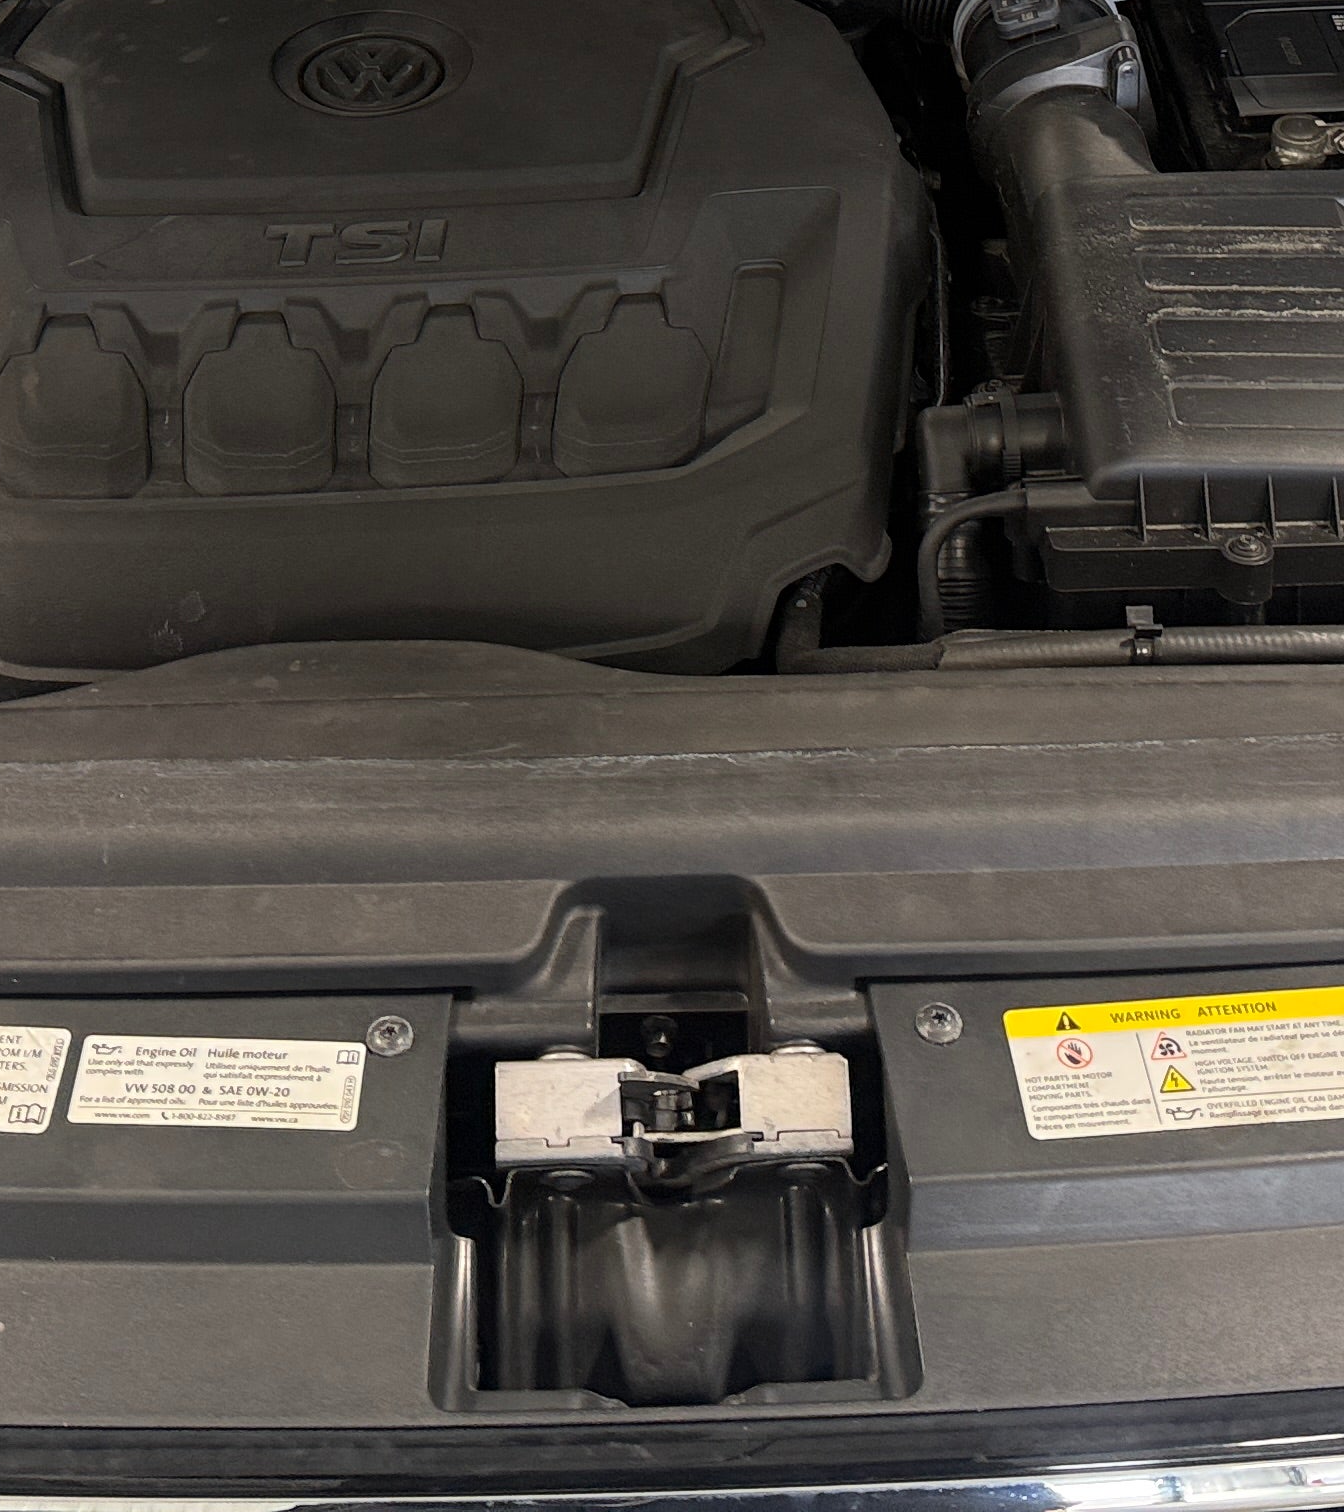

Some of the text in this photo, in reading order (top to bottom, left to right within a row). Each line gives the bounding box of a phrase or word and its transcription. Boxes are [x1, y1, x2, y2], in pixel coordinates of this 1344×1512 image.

[264, 218, 448, 268] TSI
[1110, 1001, 1277, 1024] WARNING ATTENTION
[1186, 1028, 1227, 1036] RADIATOR
[1292, 1021, 1302, 1029] AT
[1304, 1020, 1320, 1028] ANY
[1300, 1032, 1320, 1040] peut
[136, 1047, 288, 1060] Engine Oil Huile moteur
[1257, 1054, 1288, 1062] SWITCH
[1290, 1052, 1305, 1061] OFF
[1308, 1051, 1338, 1060] ENGINE
[88, 1058, 104, 1066] Use
[156, 1060, 194, 1069] expressly
[238, 1064, 290, 1072] uniquement
[86, 1068, 122, 1076] complies
[1197, 1066, 1234, 1075] IGNITION
[1044, 1074, 1070, 1083] PARTS
[1082, 1072, 1112, 1080] MOTOR
[1200, 1076, 1225, 1085] Haute
[1294, 1070, 1303, 1078] le
[1304, 1069, 1334, 1078] moteur
[125, 1083, 148, 1093] VW
[152, 1084, 175, 1093] 508
[178, 1084, 196, 1094] 00
[219, 1086, 243, 1096] SAE
[247, 1086, 290, 1097] 0W-20
[127, 1097, 168, 1105] approved
[198, 1098, 218, 1106] Pour
[1029, 1092, 1064, 1101] MOVING
[1032, 1102, 1082, 1112] Composants
[1207, 1100, 1257, 1110] OVERFILLED
[1260, 1097, 1290, 1106] ENGINE
[1293, 1096, 1306, 1104] OIL
[1044, 1112, 1105, 1121] compartiment
